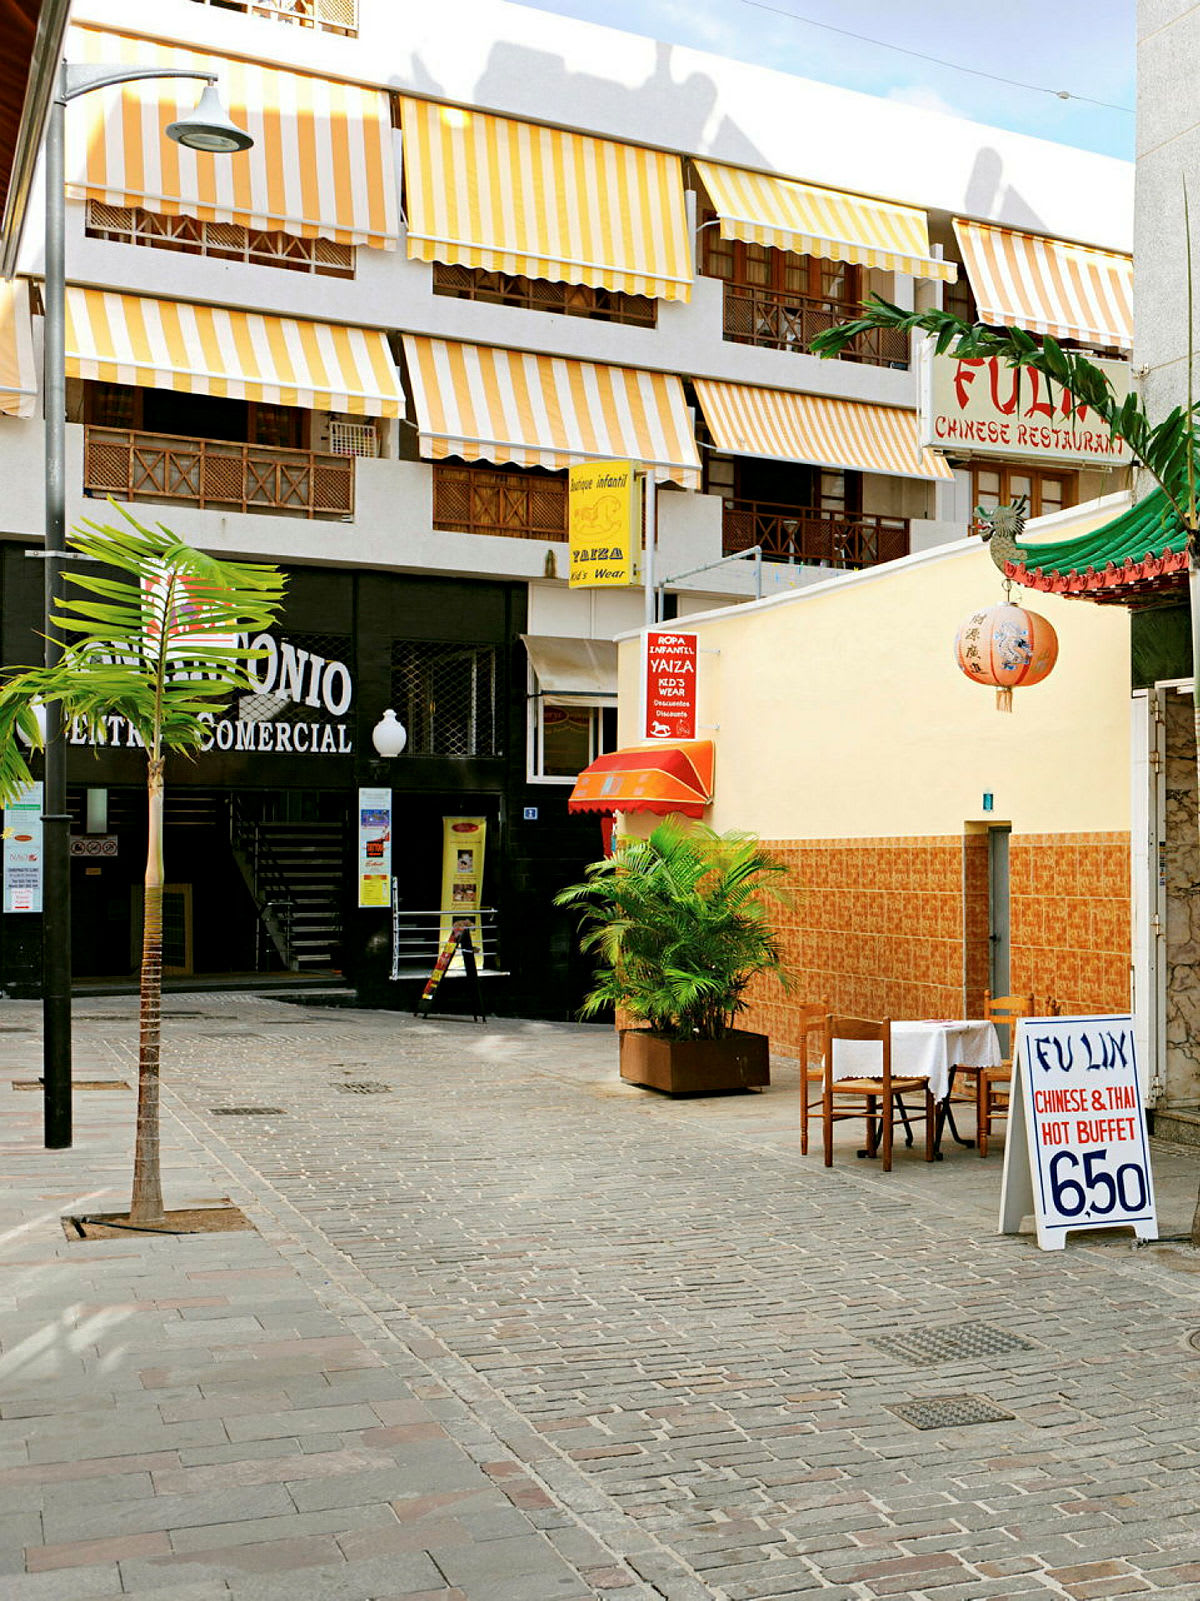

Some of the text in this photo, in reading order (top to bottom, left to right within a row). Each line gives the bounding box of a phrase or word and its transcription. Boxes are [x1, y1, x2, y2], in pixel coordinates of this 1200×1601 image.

[935, 415, 1124, 455] CHINESE RESTAURANT
[573, 547, 624, 563] YAIZA
[595, 568, 626, 579] Wear
[658, 636, 686, 645] ROPA
[649, 646, 695, 655] INFANTIL
[650, 659, 694, 673] YAIZA
[658, 678, 685, 687] KID'S
[658, 688, 685, 697] WEAR
[197, 711, 352, 753] COMERCIAL
[1034, 1031, 1128, 1073] FU LIN
[1034, 1086, 1137, 1114] CHINESE & THAI
[1042, 1117, 1137, 1146] HOT BUFFET
[1050, 1149, 1148, 1219] 6,50
